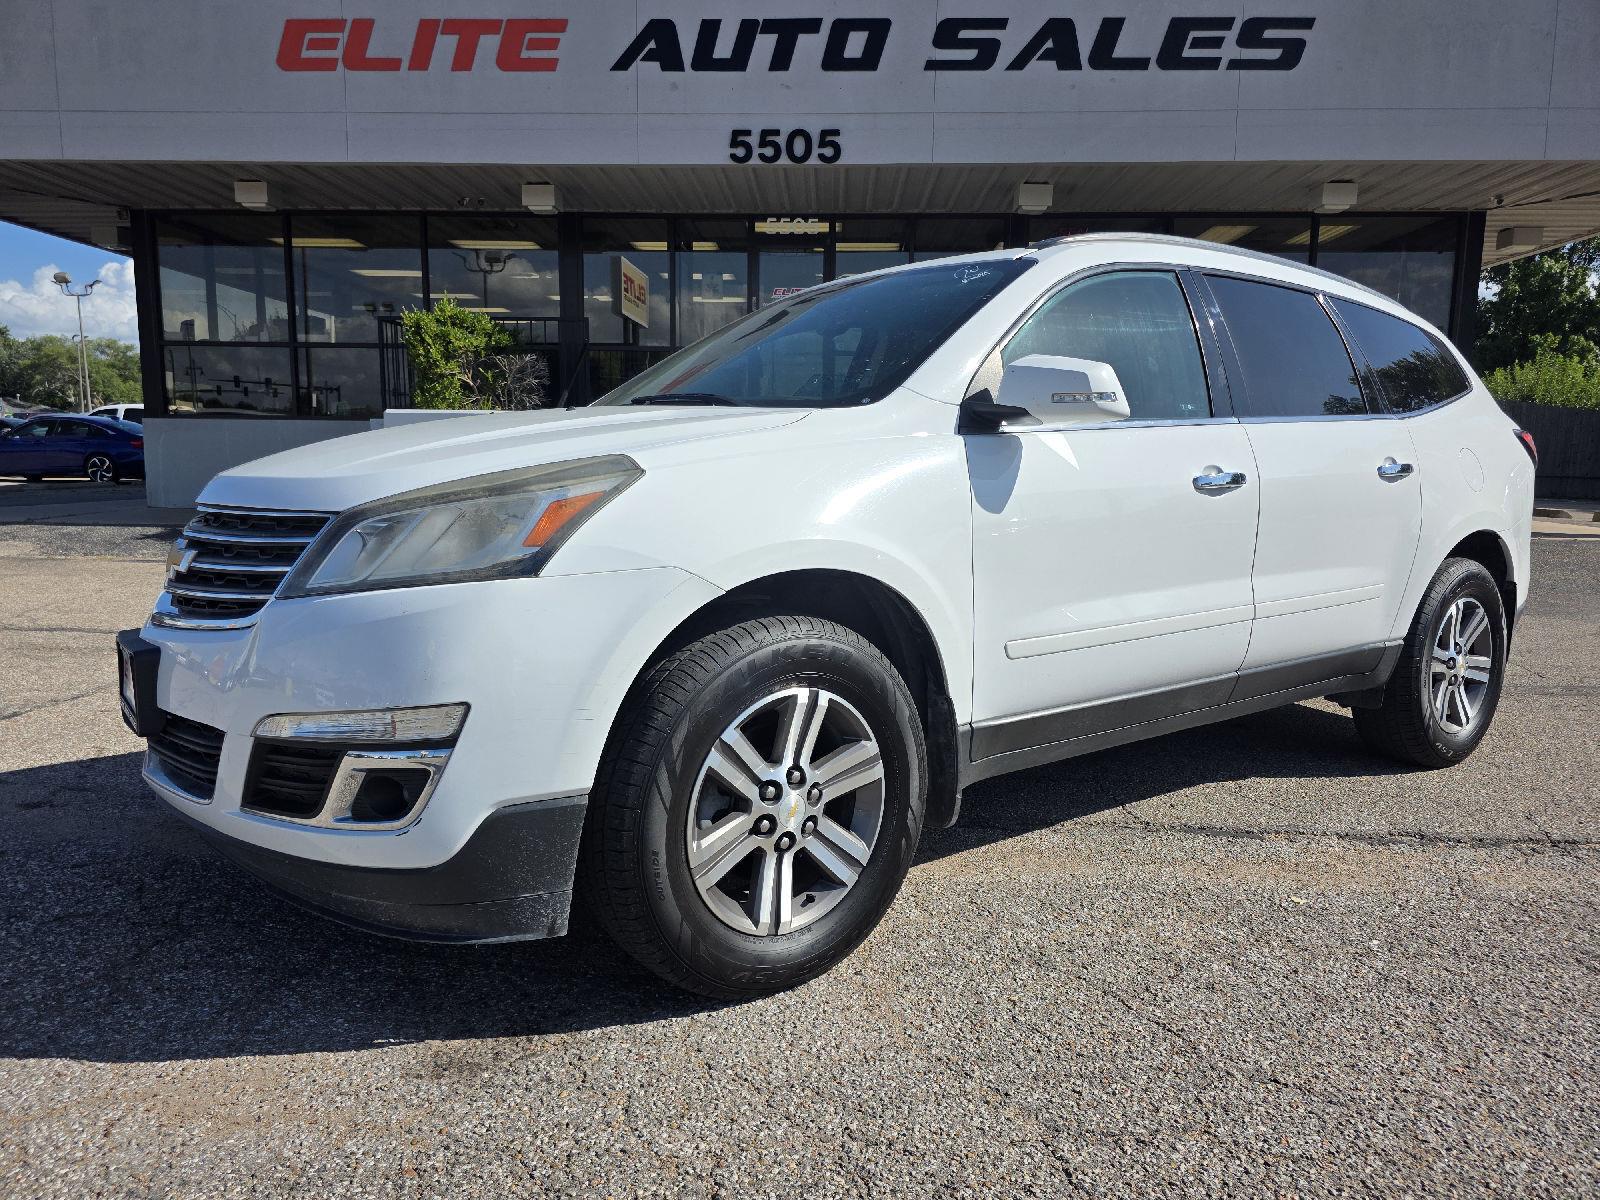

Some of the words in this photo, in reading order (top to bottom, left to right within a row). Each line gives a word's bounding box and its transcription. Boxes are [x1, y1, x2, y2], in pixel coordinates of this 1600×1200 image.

[276, 18, 568, 72] ELITE
[610, 18, 892, 72] AUTO
[924, 16, 1316, 71] SALES
[729, 128, 842, 166] 5505
